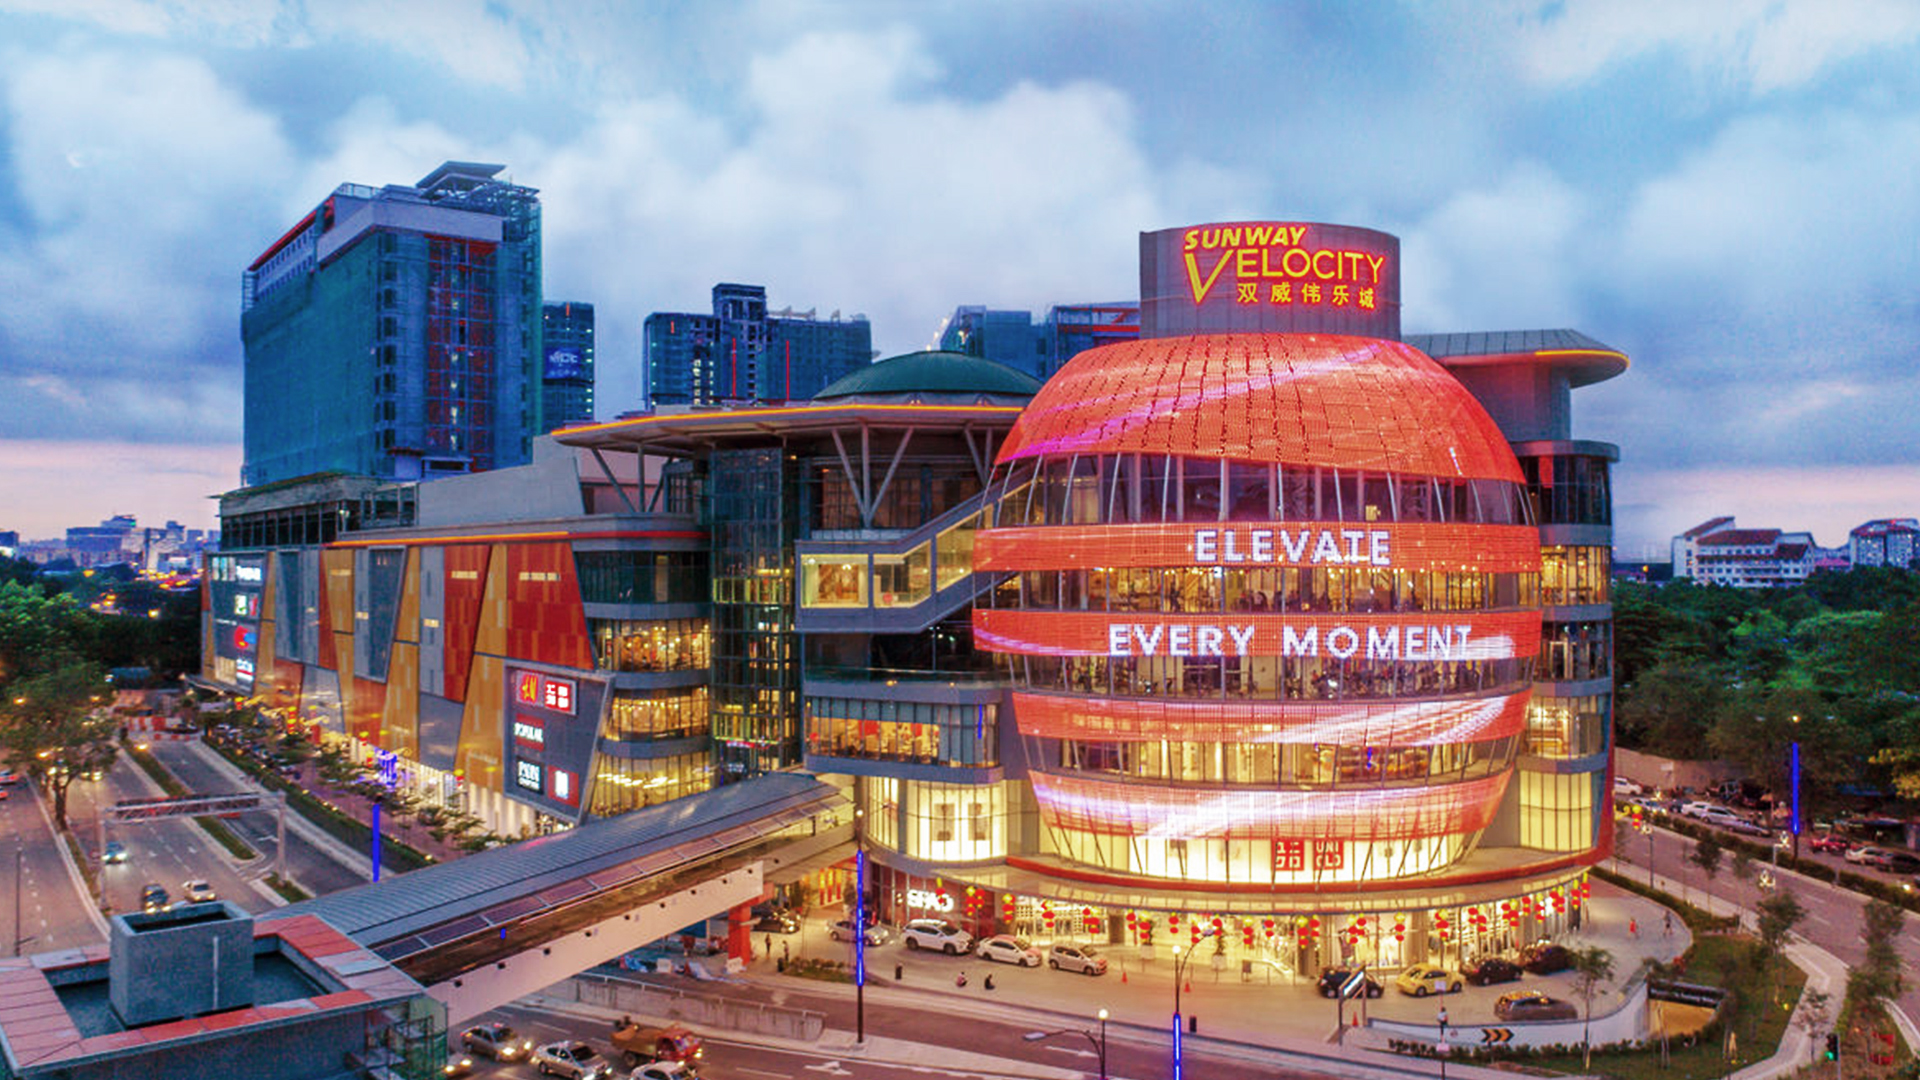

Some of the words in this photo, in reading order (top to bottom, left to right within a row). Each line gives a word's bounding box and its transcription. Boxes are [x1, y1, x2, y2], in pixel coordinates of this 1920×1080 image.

[1184, 226, 1306, 250] SUNWAY
[1184, 248, 1384, 303] VELOCITY
[1237, 282, 1376, 308] 双威伟乐城
[1194, 529, 1391, 565] ELEVATE
[1108, 624, 1254, 657] EVERY
[1282, 625, 1473, 660] MOMENT
[1316, 841, 1339, 852] UNI
